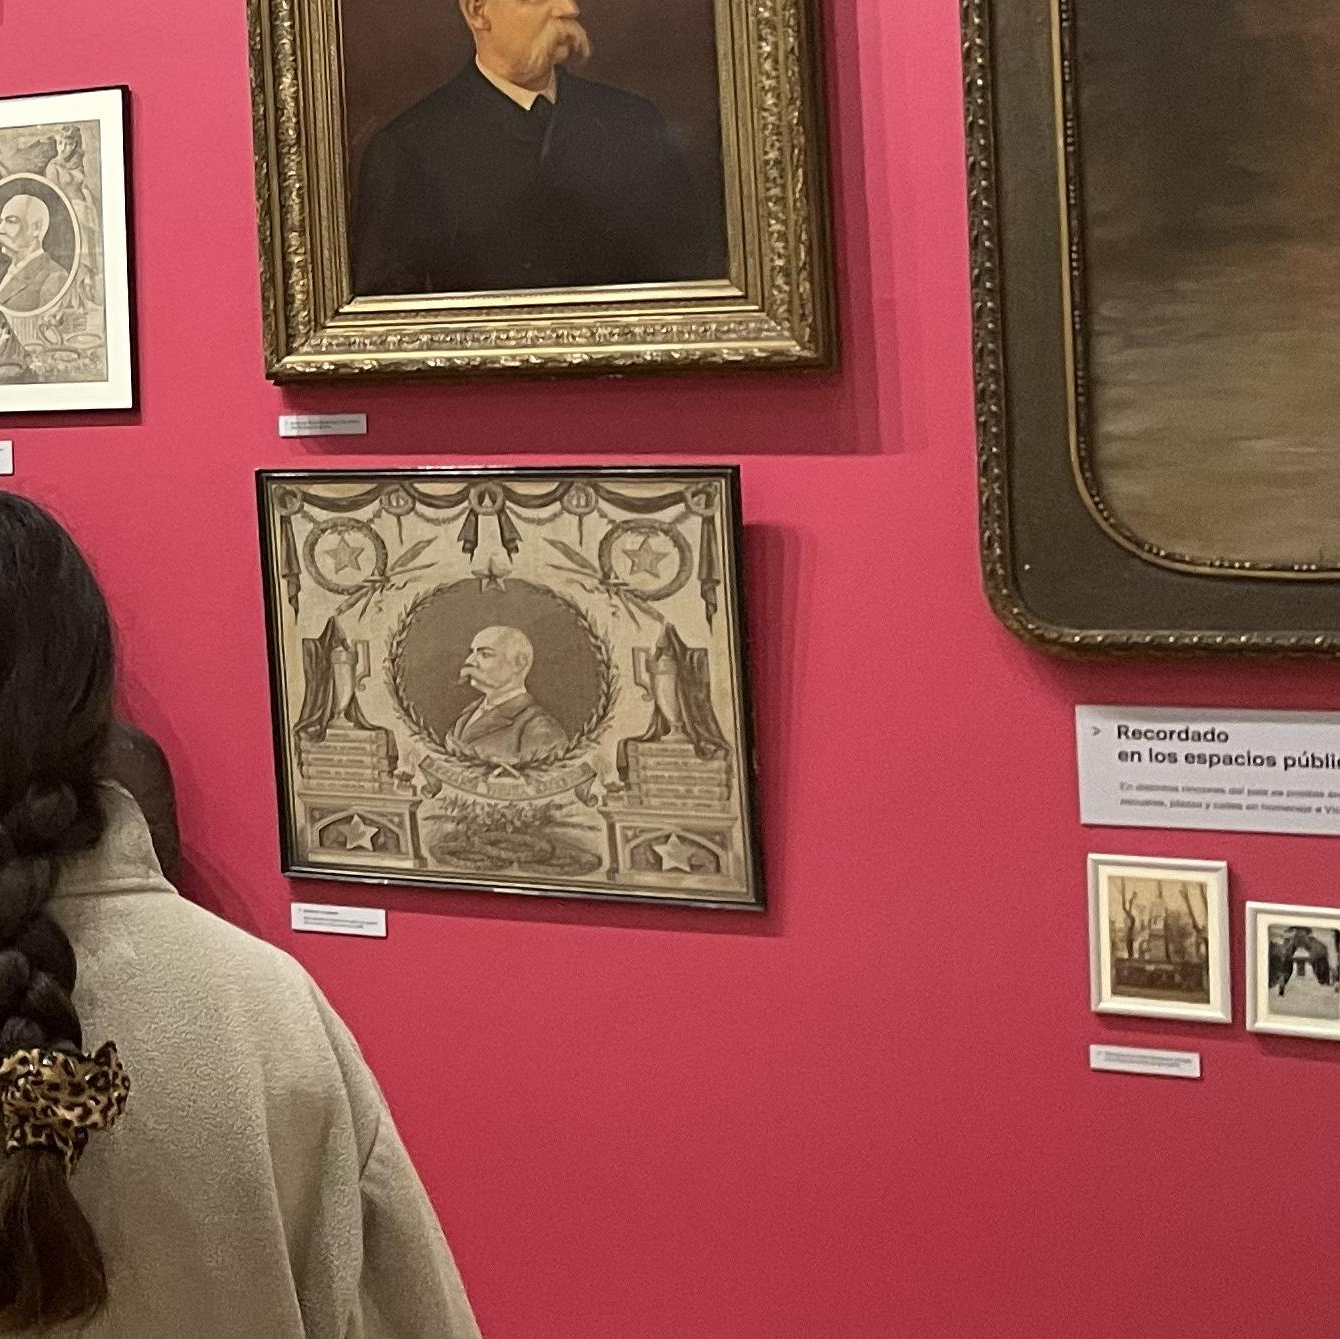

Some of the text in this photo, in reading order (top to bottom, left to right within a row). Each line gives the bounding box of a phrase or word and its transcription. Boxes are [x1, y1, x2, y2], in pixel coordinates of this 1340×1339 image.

[1117, 725, 1229, 743] Recordado
[1118, 750, 1142, 763] en
[1149, 748, 1178, 764] los
[1185, 750, 1277, 768] espacios
